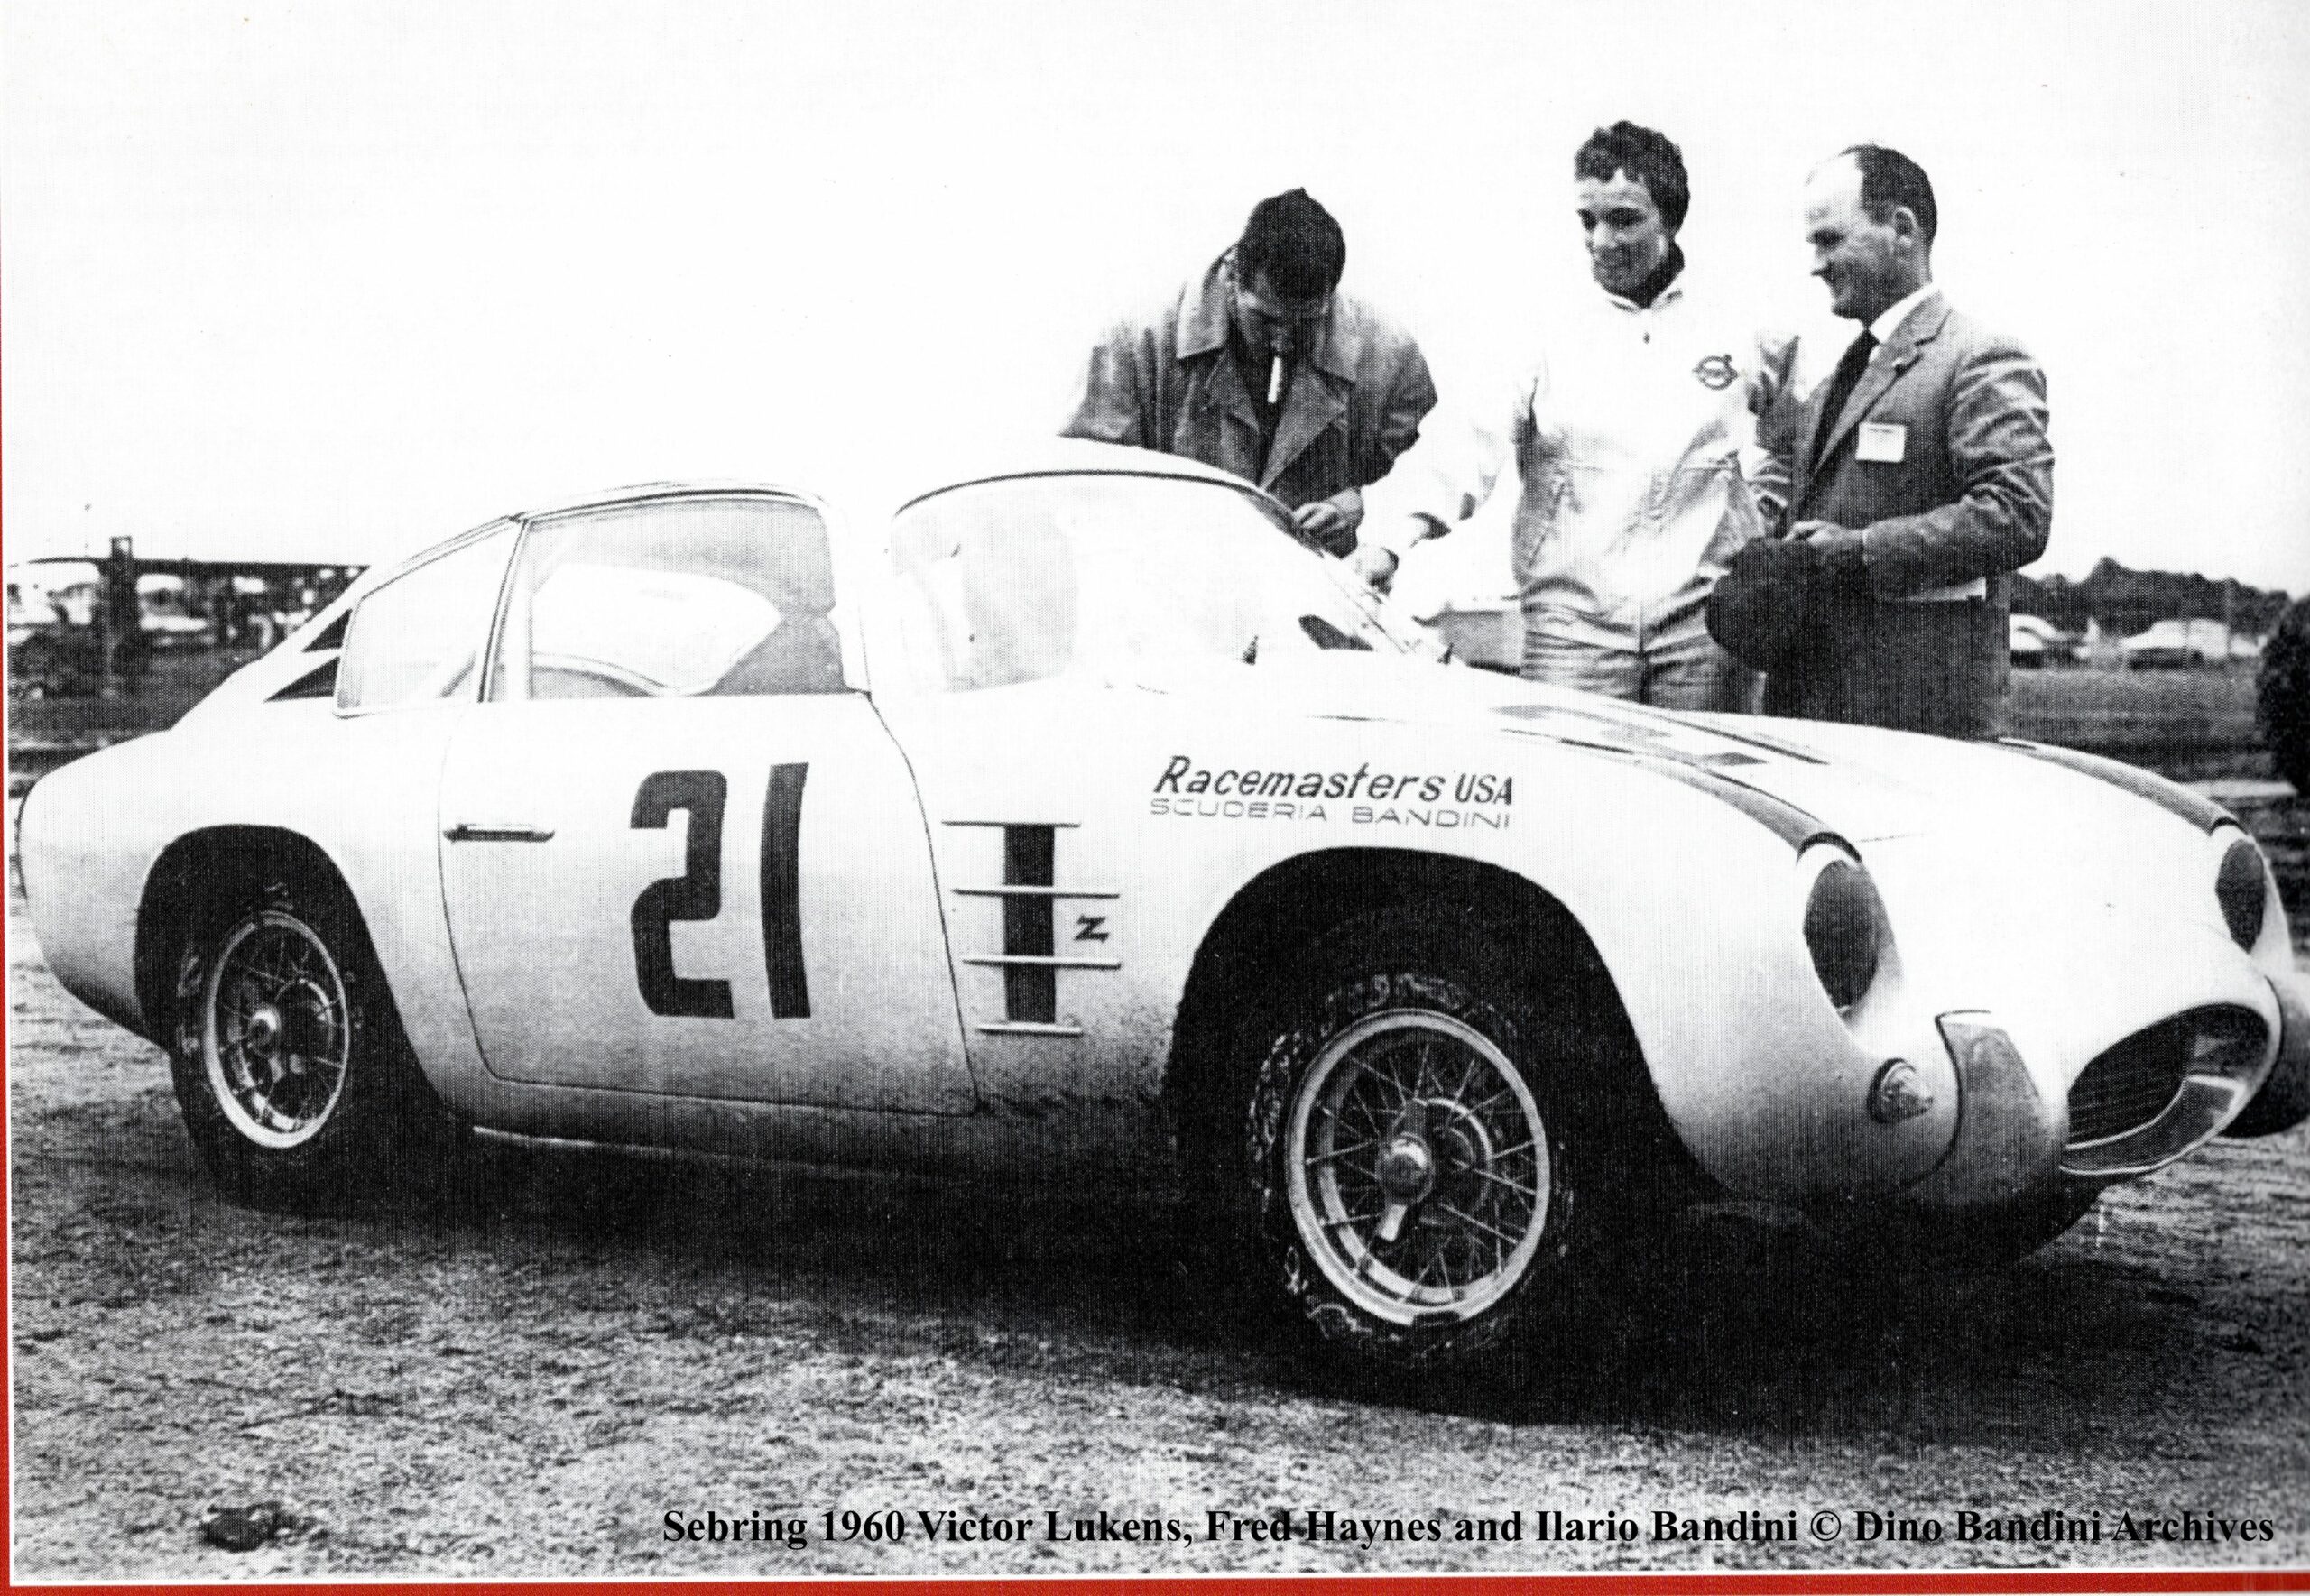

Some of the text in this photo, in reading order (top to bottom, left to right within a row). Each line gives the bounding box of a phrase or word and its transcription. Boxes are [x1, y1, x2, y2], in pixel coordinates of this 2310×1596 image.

[1153, 754, 1513, 806] Racemasters USA
[1150, 798, 1510, 829] SCUDERIA BANDINI
[630, 762, 812, 1020] 21
